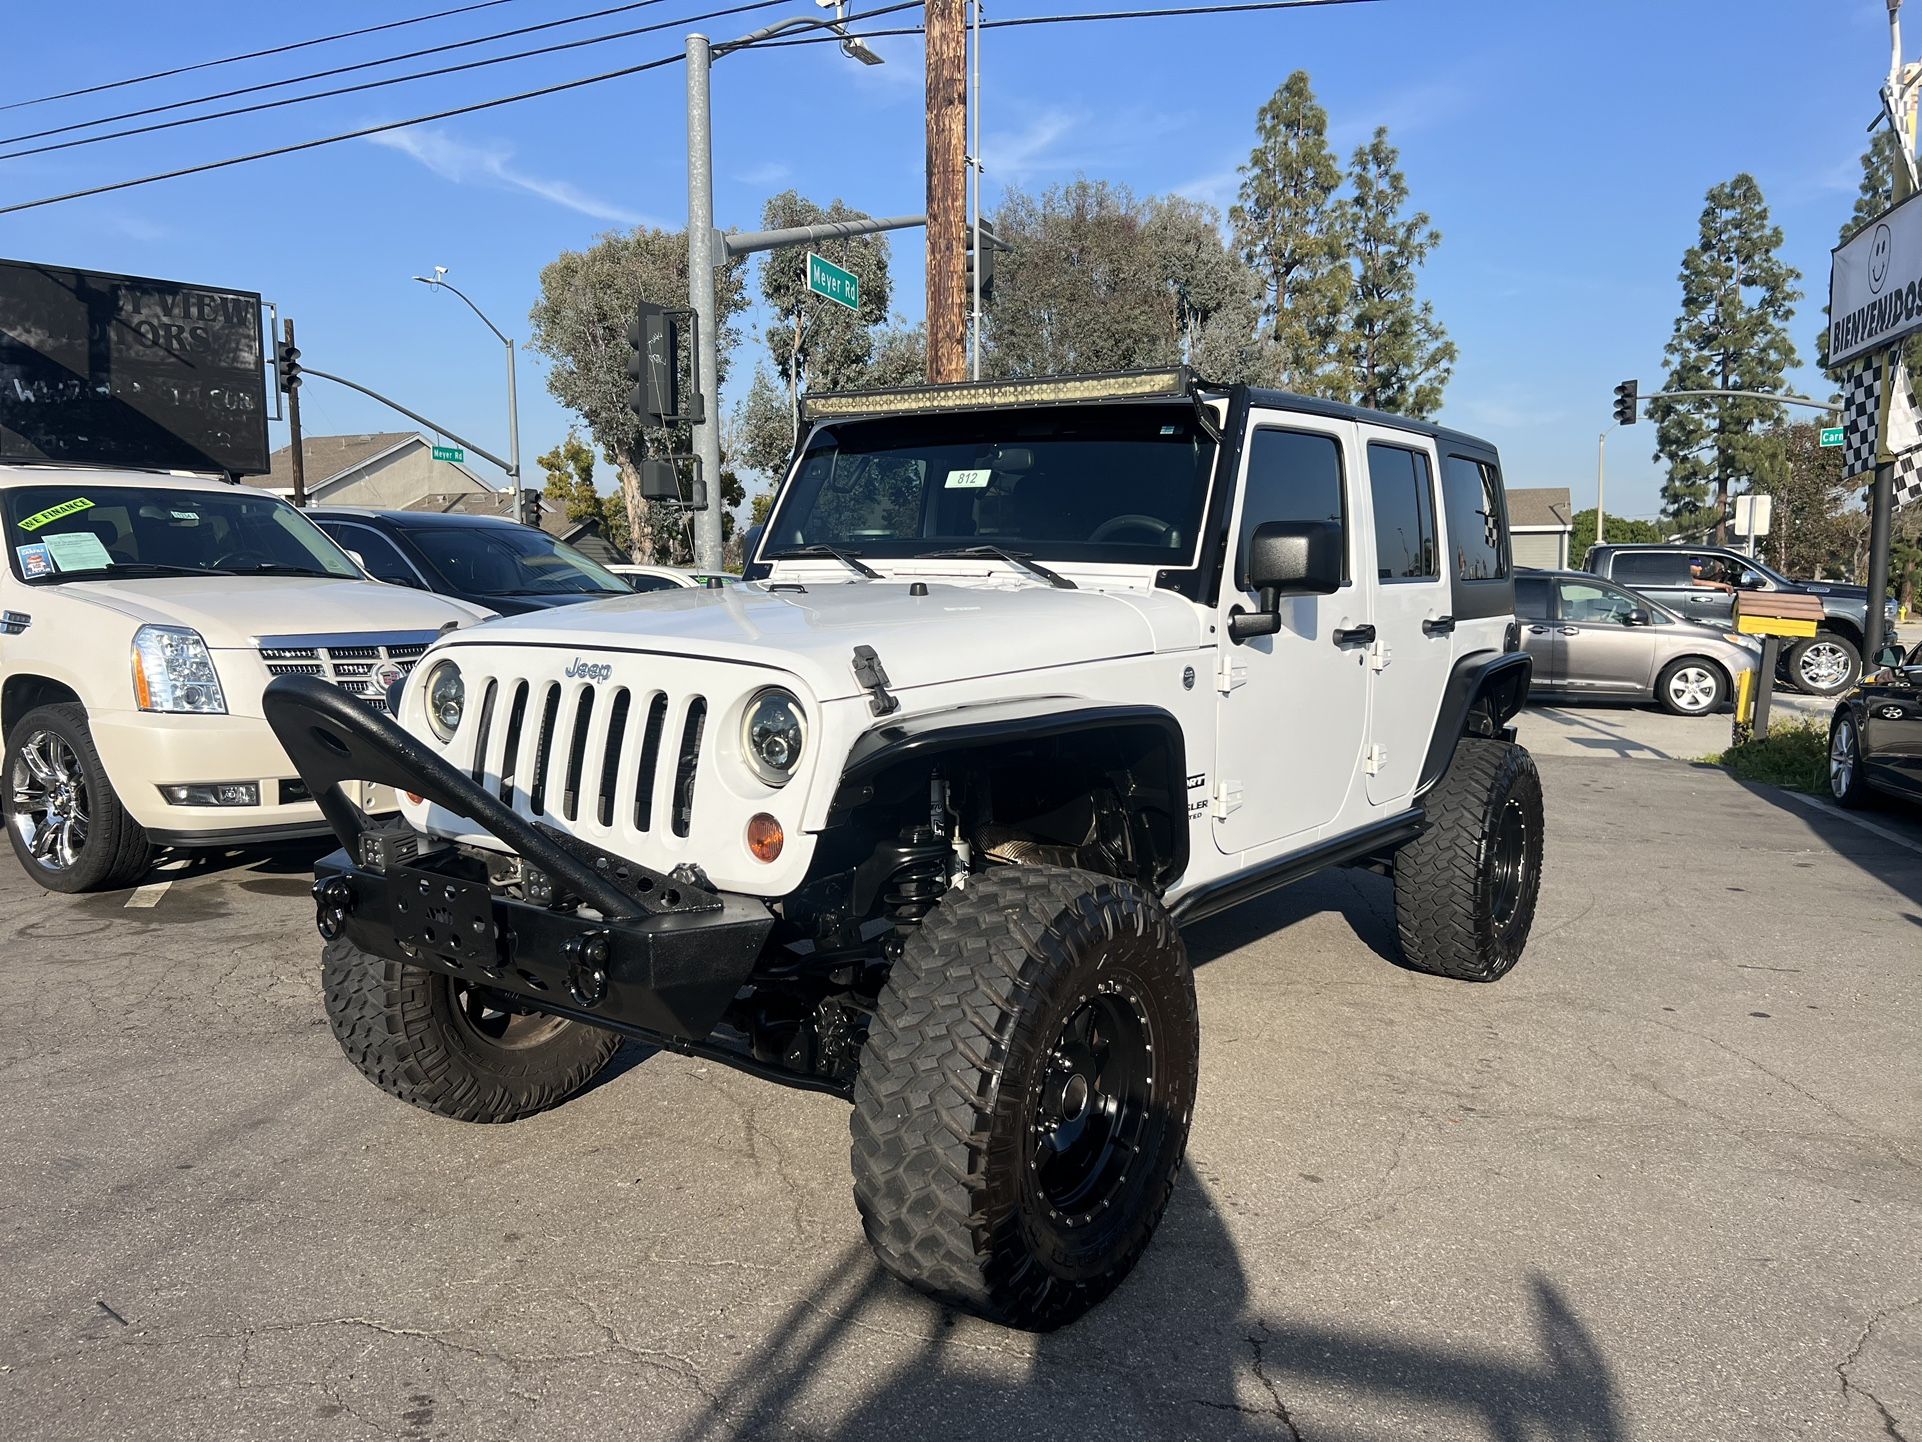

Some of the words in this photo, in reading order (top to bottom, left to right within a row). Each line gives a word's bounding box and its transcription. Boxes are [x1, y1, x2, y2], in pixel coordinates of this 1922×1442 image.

[813, 264, 840, 293] Meyer
[845, 279, 856, 301] Rd
[157, 290, 251, 326] VIEW
[433, 449, 452, 459] Meyer
[454, 451, 462, 460] Rd
[957, 472, 978, 485] 812
[21, 516, 43, 529] WE
[41, 499, 91, 520] FINANCE
[565, 656, 613, 684] Jeep
